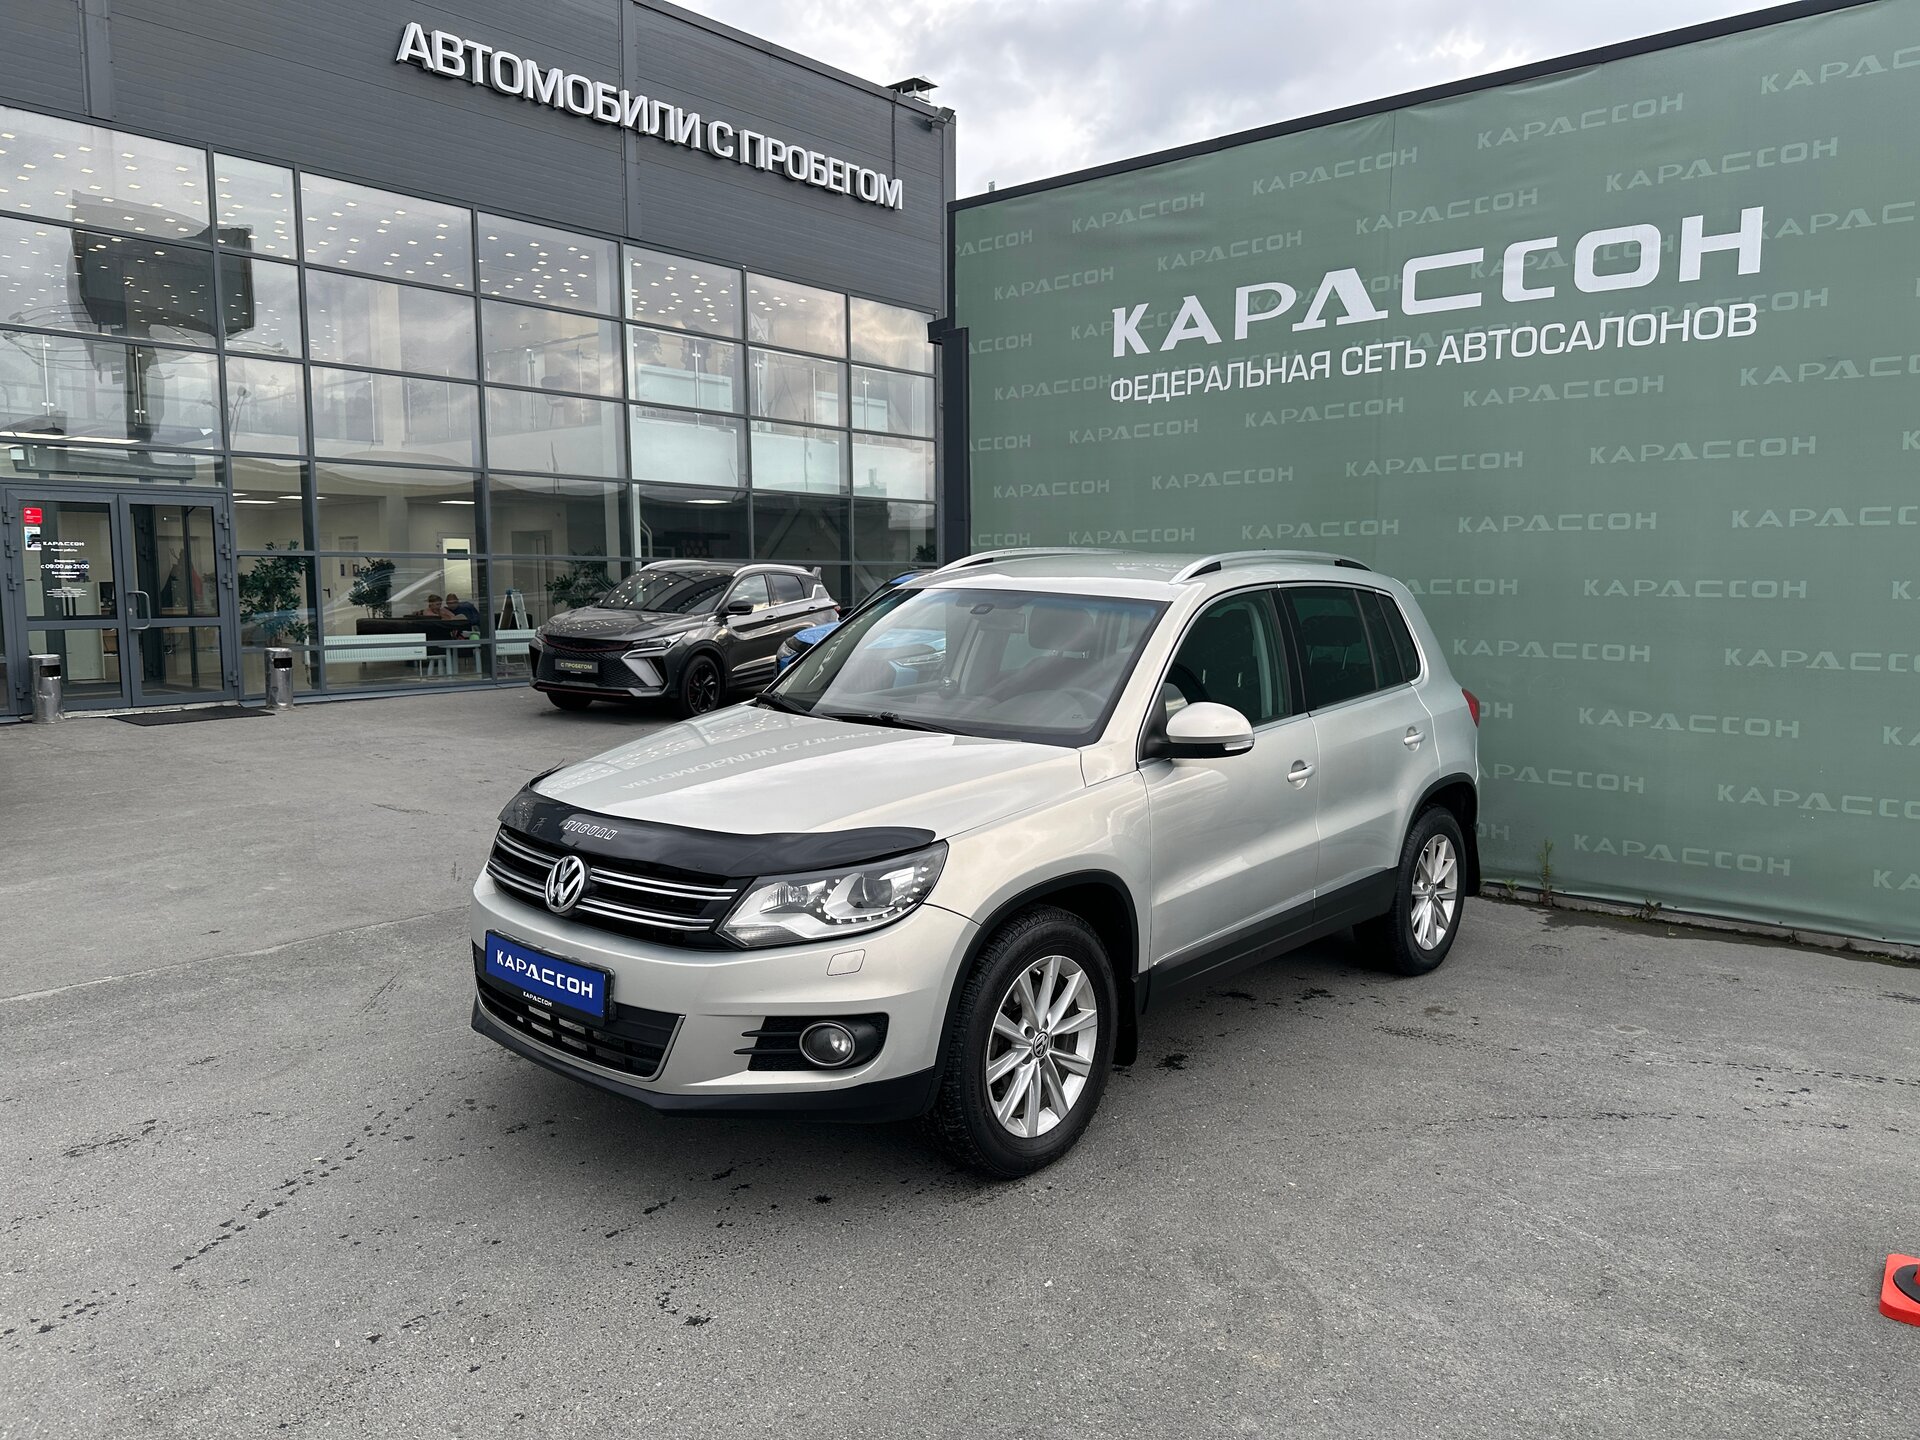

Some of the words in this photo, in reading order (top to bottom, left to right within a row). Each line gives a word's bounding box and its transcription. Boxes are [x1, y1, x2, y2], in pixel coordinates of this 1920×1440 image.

[396, 21, 700, 149] АВТОМОБИЛИ
[707, 120, 734, 159] С
[738, 128, 903, 210] ПРОБЕГОМ
[1110, 350, 1331, 404] ФЕДЕРАЛЬНАЯ
[1341, 340, 1427, 376] СЕТЬ
[1436, 302, 1758, 366] АВТОСАЛОНОВ
[563, 820, 618, 840] TIGUAN
